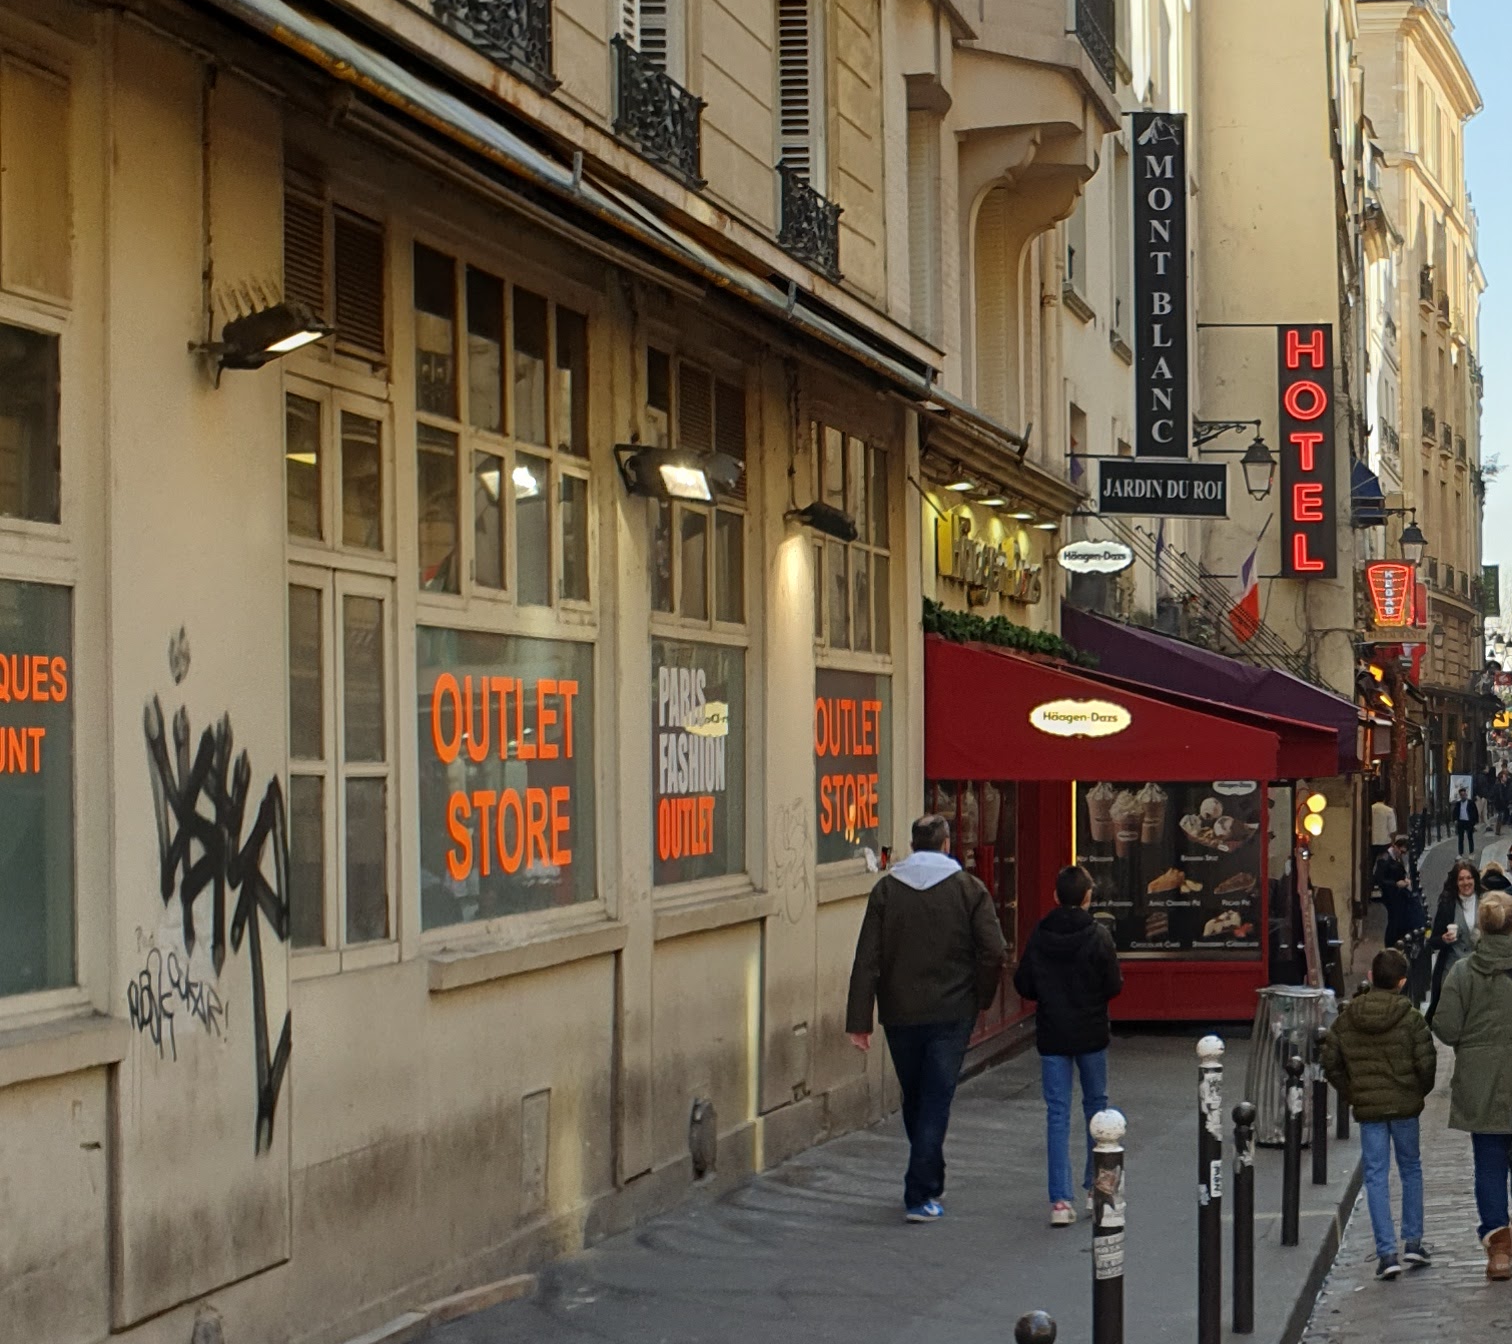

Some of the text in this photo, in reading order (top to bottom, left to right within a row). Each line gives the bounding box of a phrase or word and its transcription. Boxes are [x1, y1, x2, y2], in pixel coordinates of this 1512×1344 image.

[1145, 154, 1174, 445] MONT BLANC
[1283, 329, 1328, 572] HOTEL
[1103, 478, 1223, 500] JARDIN DU ROI
[0, 653, 68, 703] QUES
[658, 666, 706, 727] PARIS
[432, 672, 579, 764] OUTLET
[814, 697, 883, 757] OUTLET
[1043, 711, 1119, 725] Häagen-Dazs
[658, 732, 725, 795] FASHION
[446, 786, 573, 882] STORE
[657, 796, 716, 861] OUTLET
[819, 773, 880, 835] STORE
